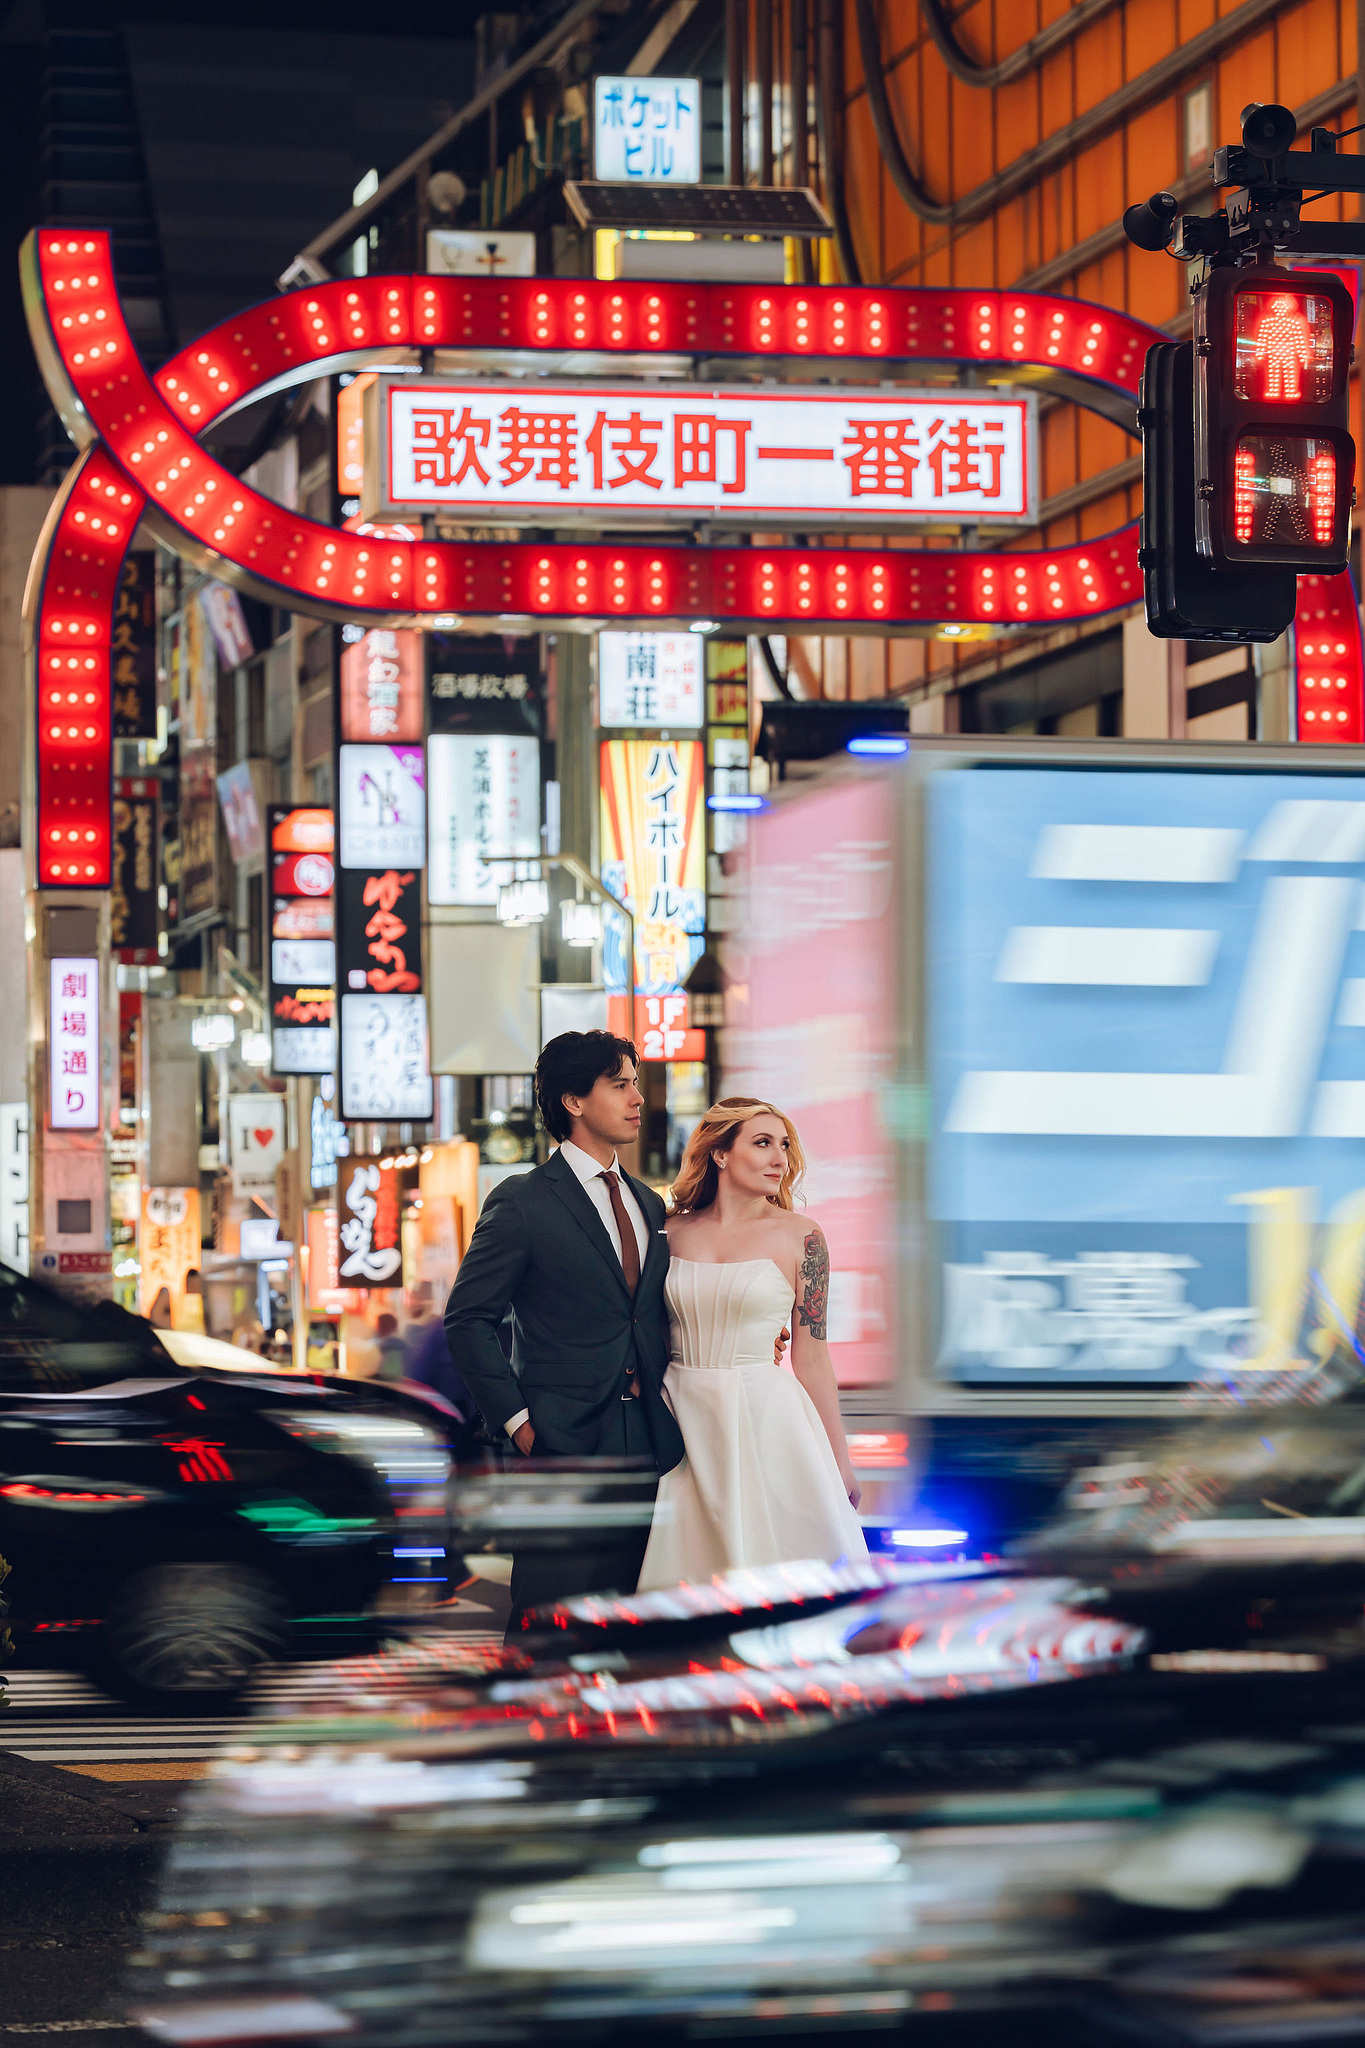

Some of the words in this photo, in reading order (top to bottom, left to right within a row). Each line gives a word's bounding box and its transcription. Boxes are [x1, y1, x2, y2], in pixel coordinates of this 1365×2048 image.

[602, 83, 692, 132] ポケット
[624, 135, 675, 176] ビル
[411, 406, 1007, 499] 歌舞伎町一番街
[649, 751, 680, 918] ハイボール
[645, 997, 687, 1026] 1F
[61, 972, 88, 1113] 劇場通り
[643, 1030, 687, 1059] 2F
[240, 1126, 250, 1151] I
